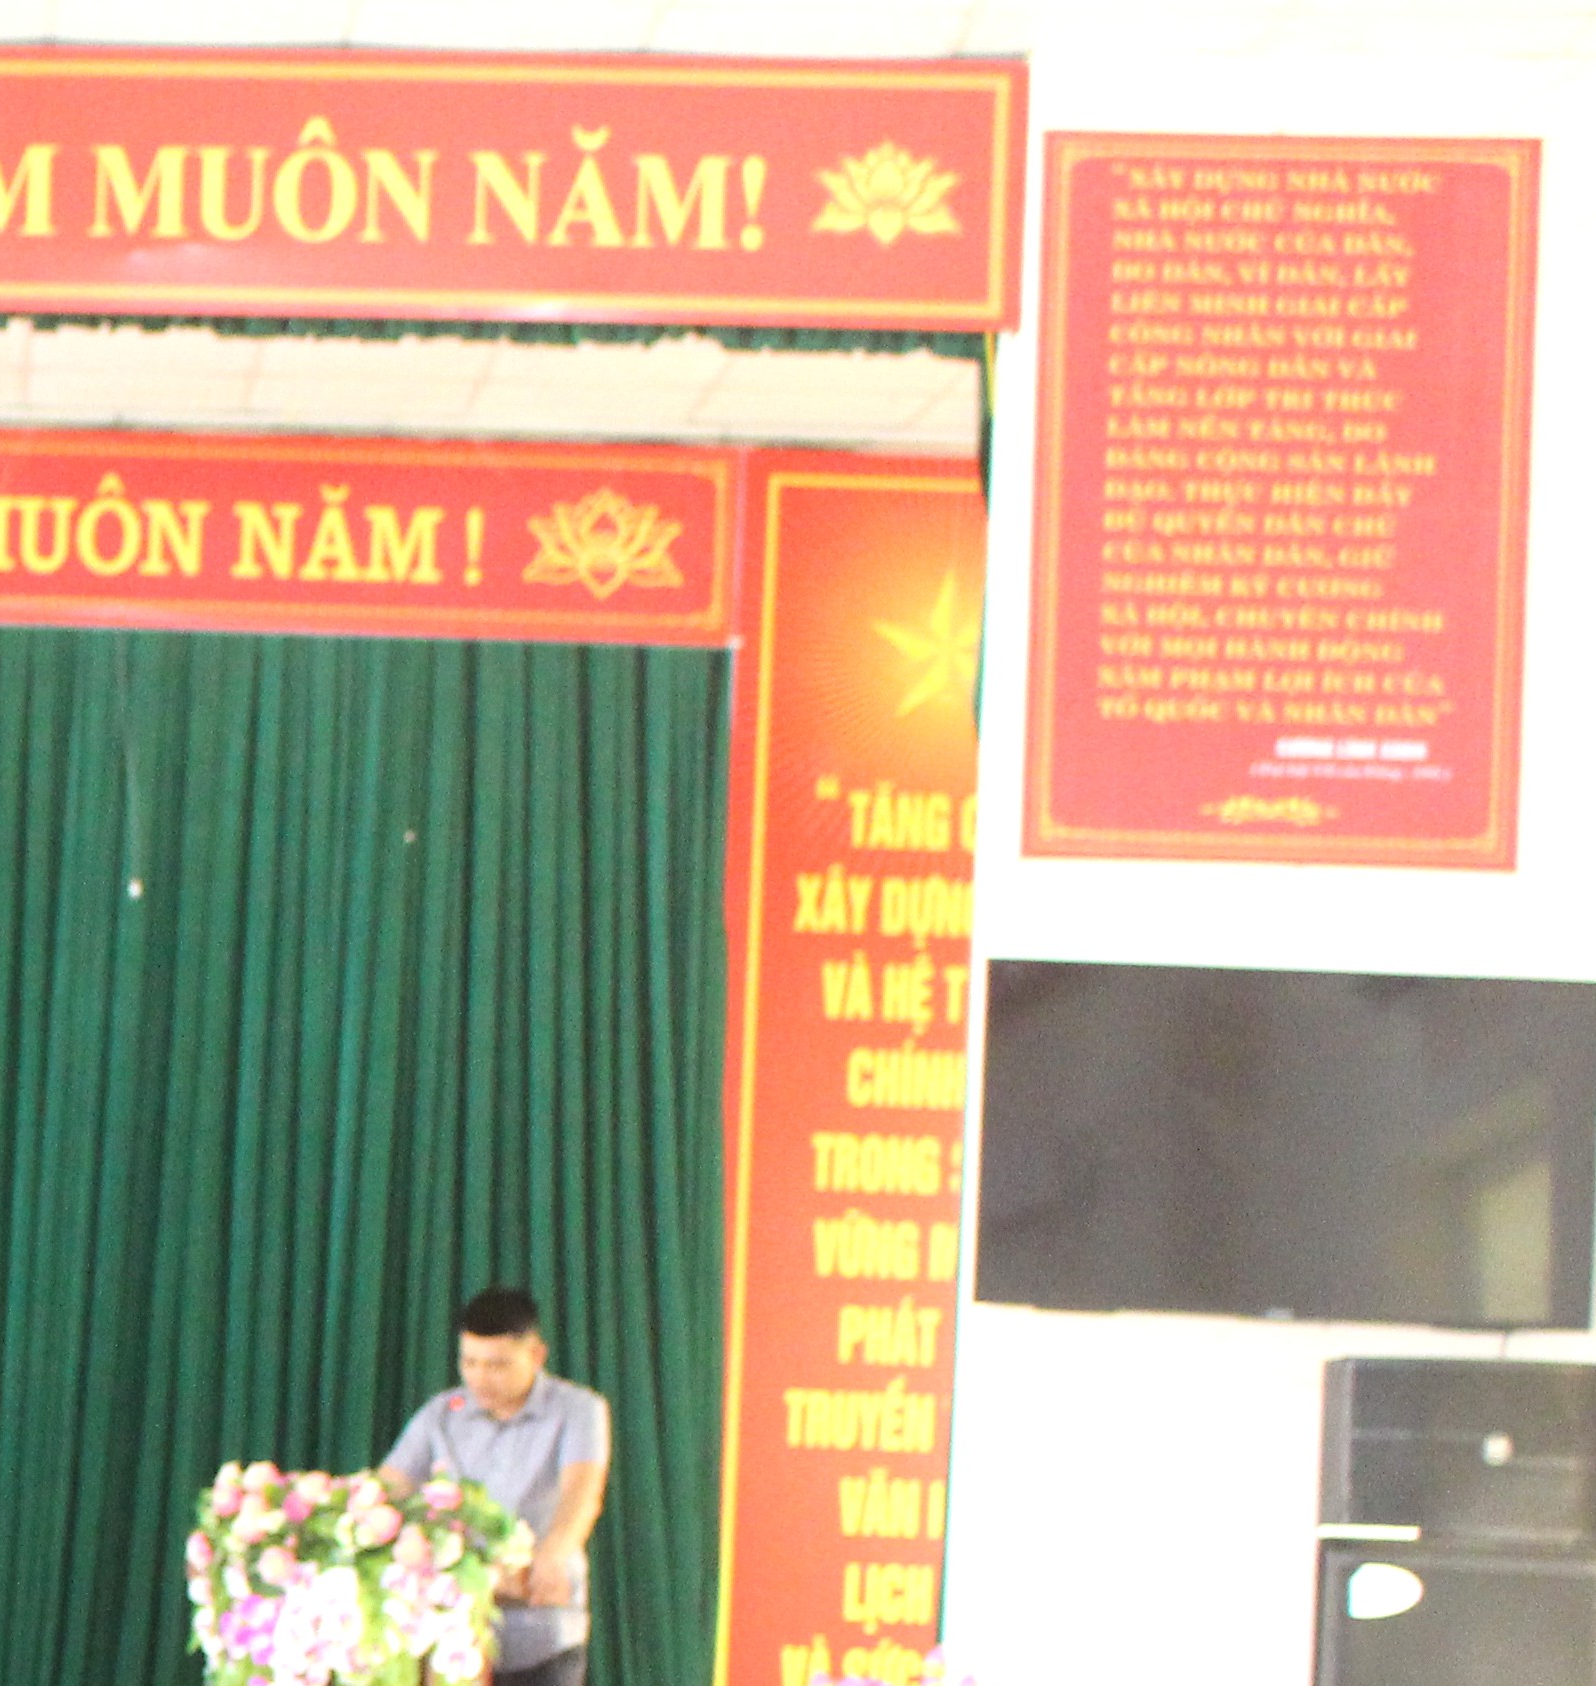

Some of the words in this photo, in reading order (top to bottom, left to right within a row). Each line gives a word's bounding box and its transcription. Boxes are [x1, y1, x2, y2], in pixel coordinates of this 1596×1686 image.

[89, 115, 438, 245] MUÔN
[466, 124, 768, 253] NĂM!
[230, 485, 445, 586] NĂM
[793, 863, 872, 933] XÂY
[821, 950, 872, 1021] VÀ
[882, 946, 934, 1037] HỆ
[811, 1131, 941, 1196] TRONG
[837, 1294, 941, 1368] PHÁT
[842, 1561, 935, 1636] LỊCH
